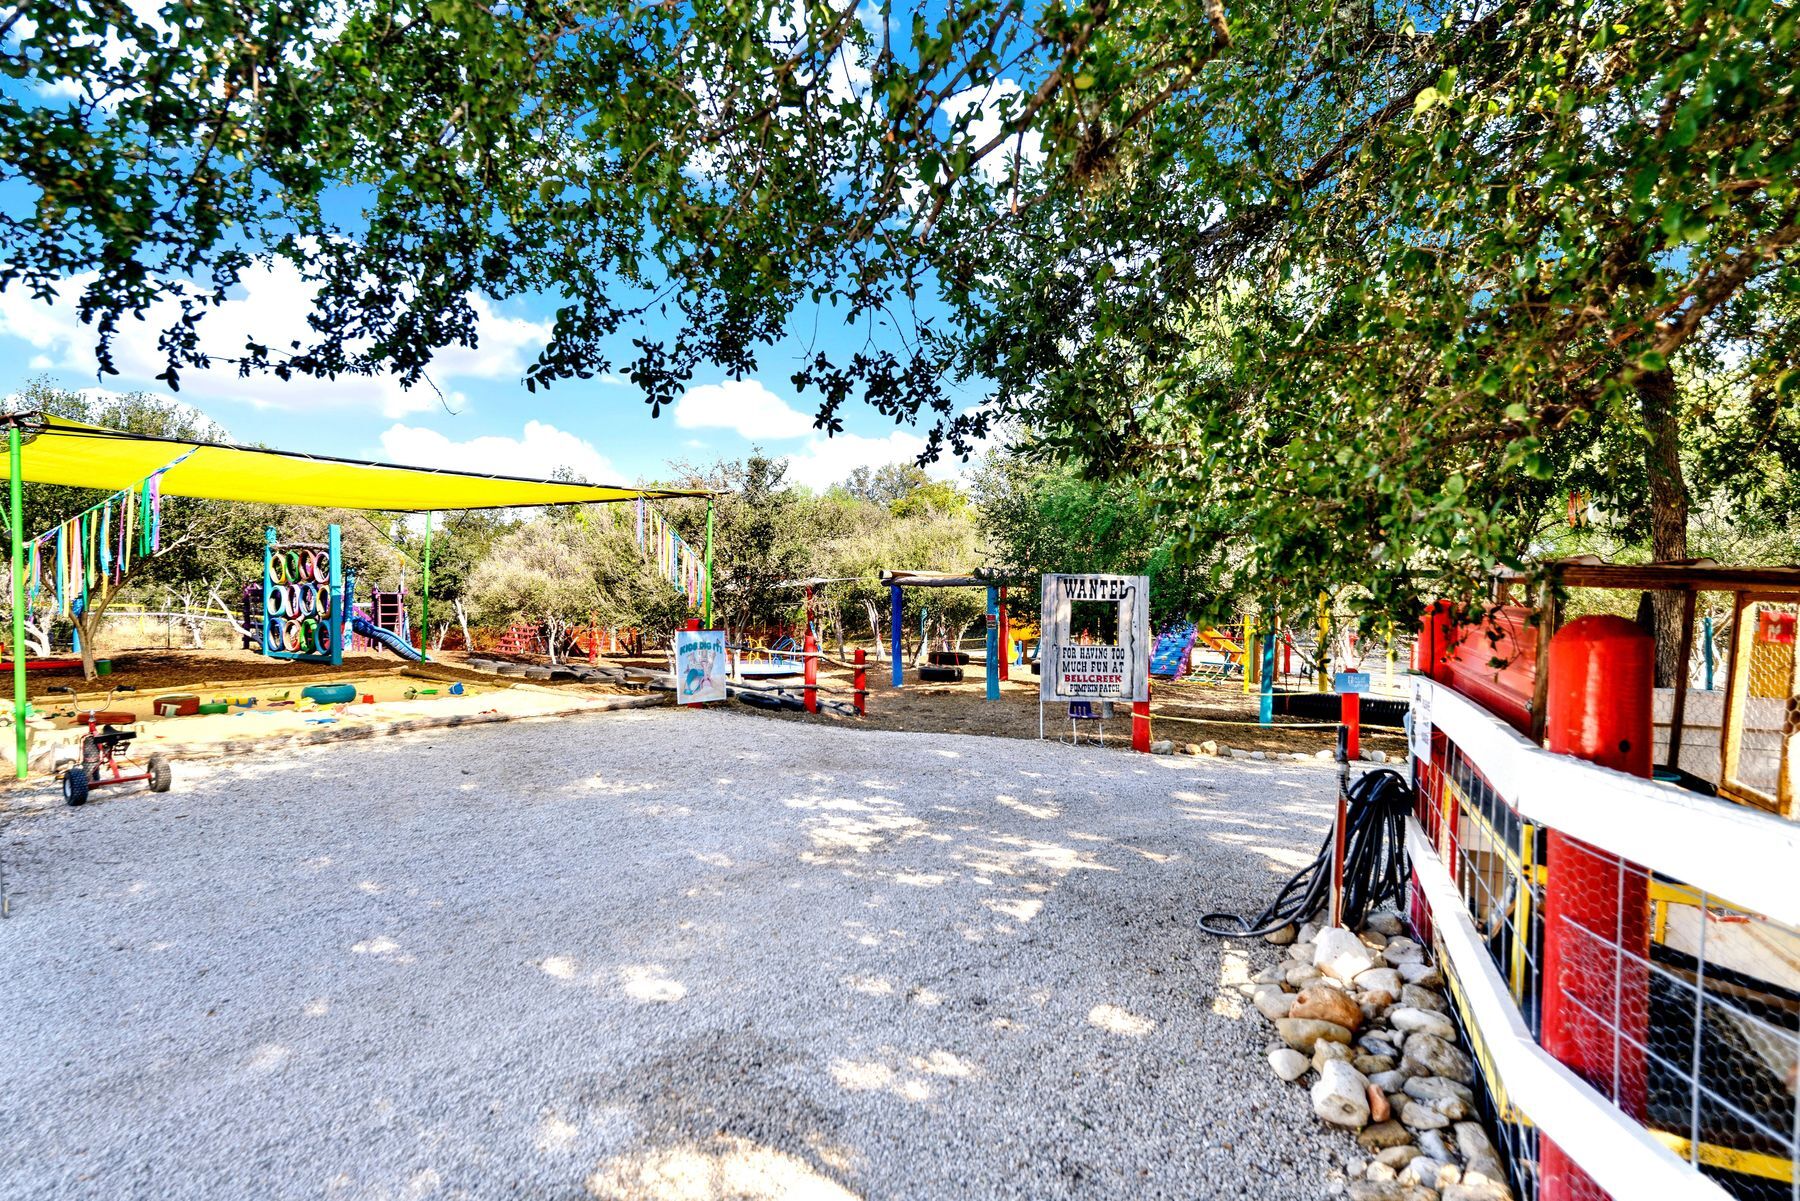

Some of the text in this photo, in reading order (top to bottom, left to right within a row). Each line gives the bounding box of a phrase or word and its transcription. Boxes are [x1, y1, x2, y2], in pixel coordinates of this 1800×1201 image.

[1063, 579, 1128, 600] WANTED
[680, 642, 698, 656] KIDS
[699, 641, 712, 650] DIG
[1062, 647, 1125, 660] FOR HAVING TOO
[1062, 661, 1125, 673] MUCH FUN AT
[1064, 674, 1122, 683] BELLCREEK
[1070, 683, 1120, 693] PUMPKIN PATCH
